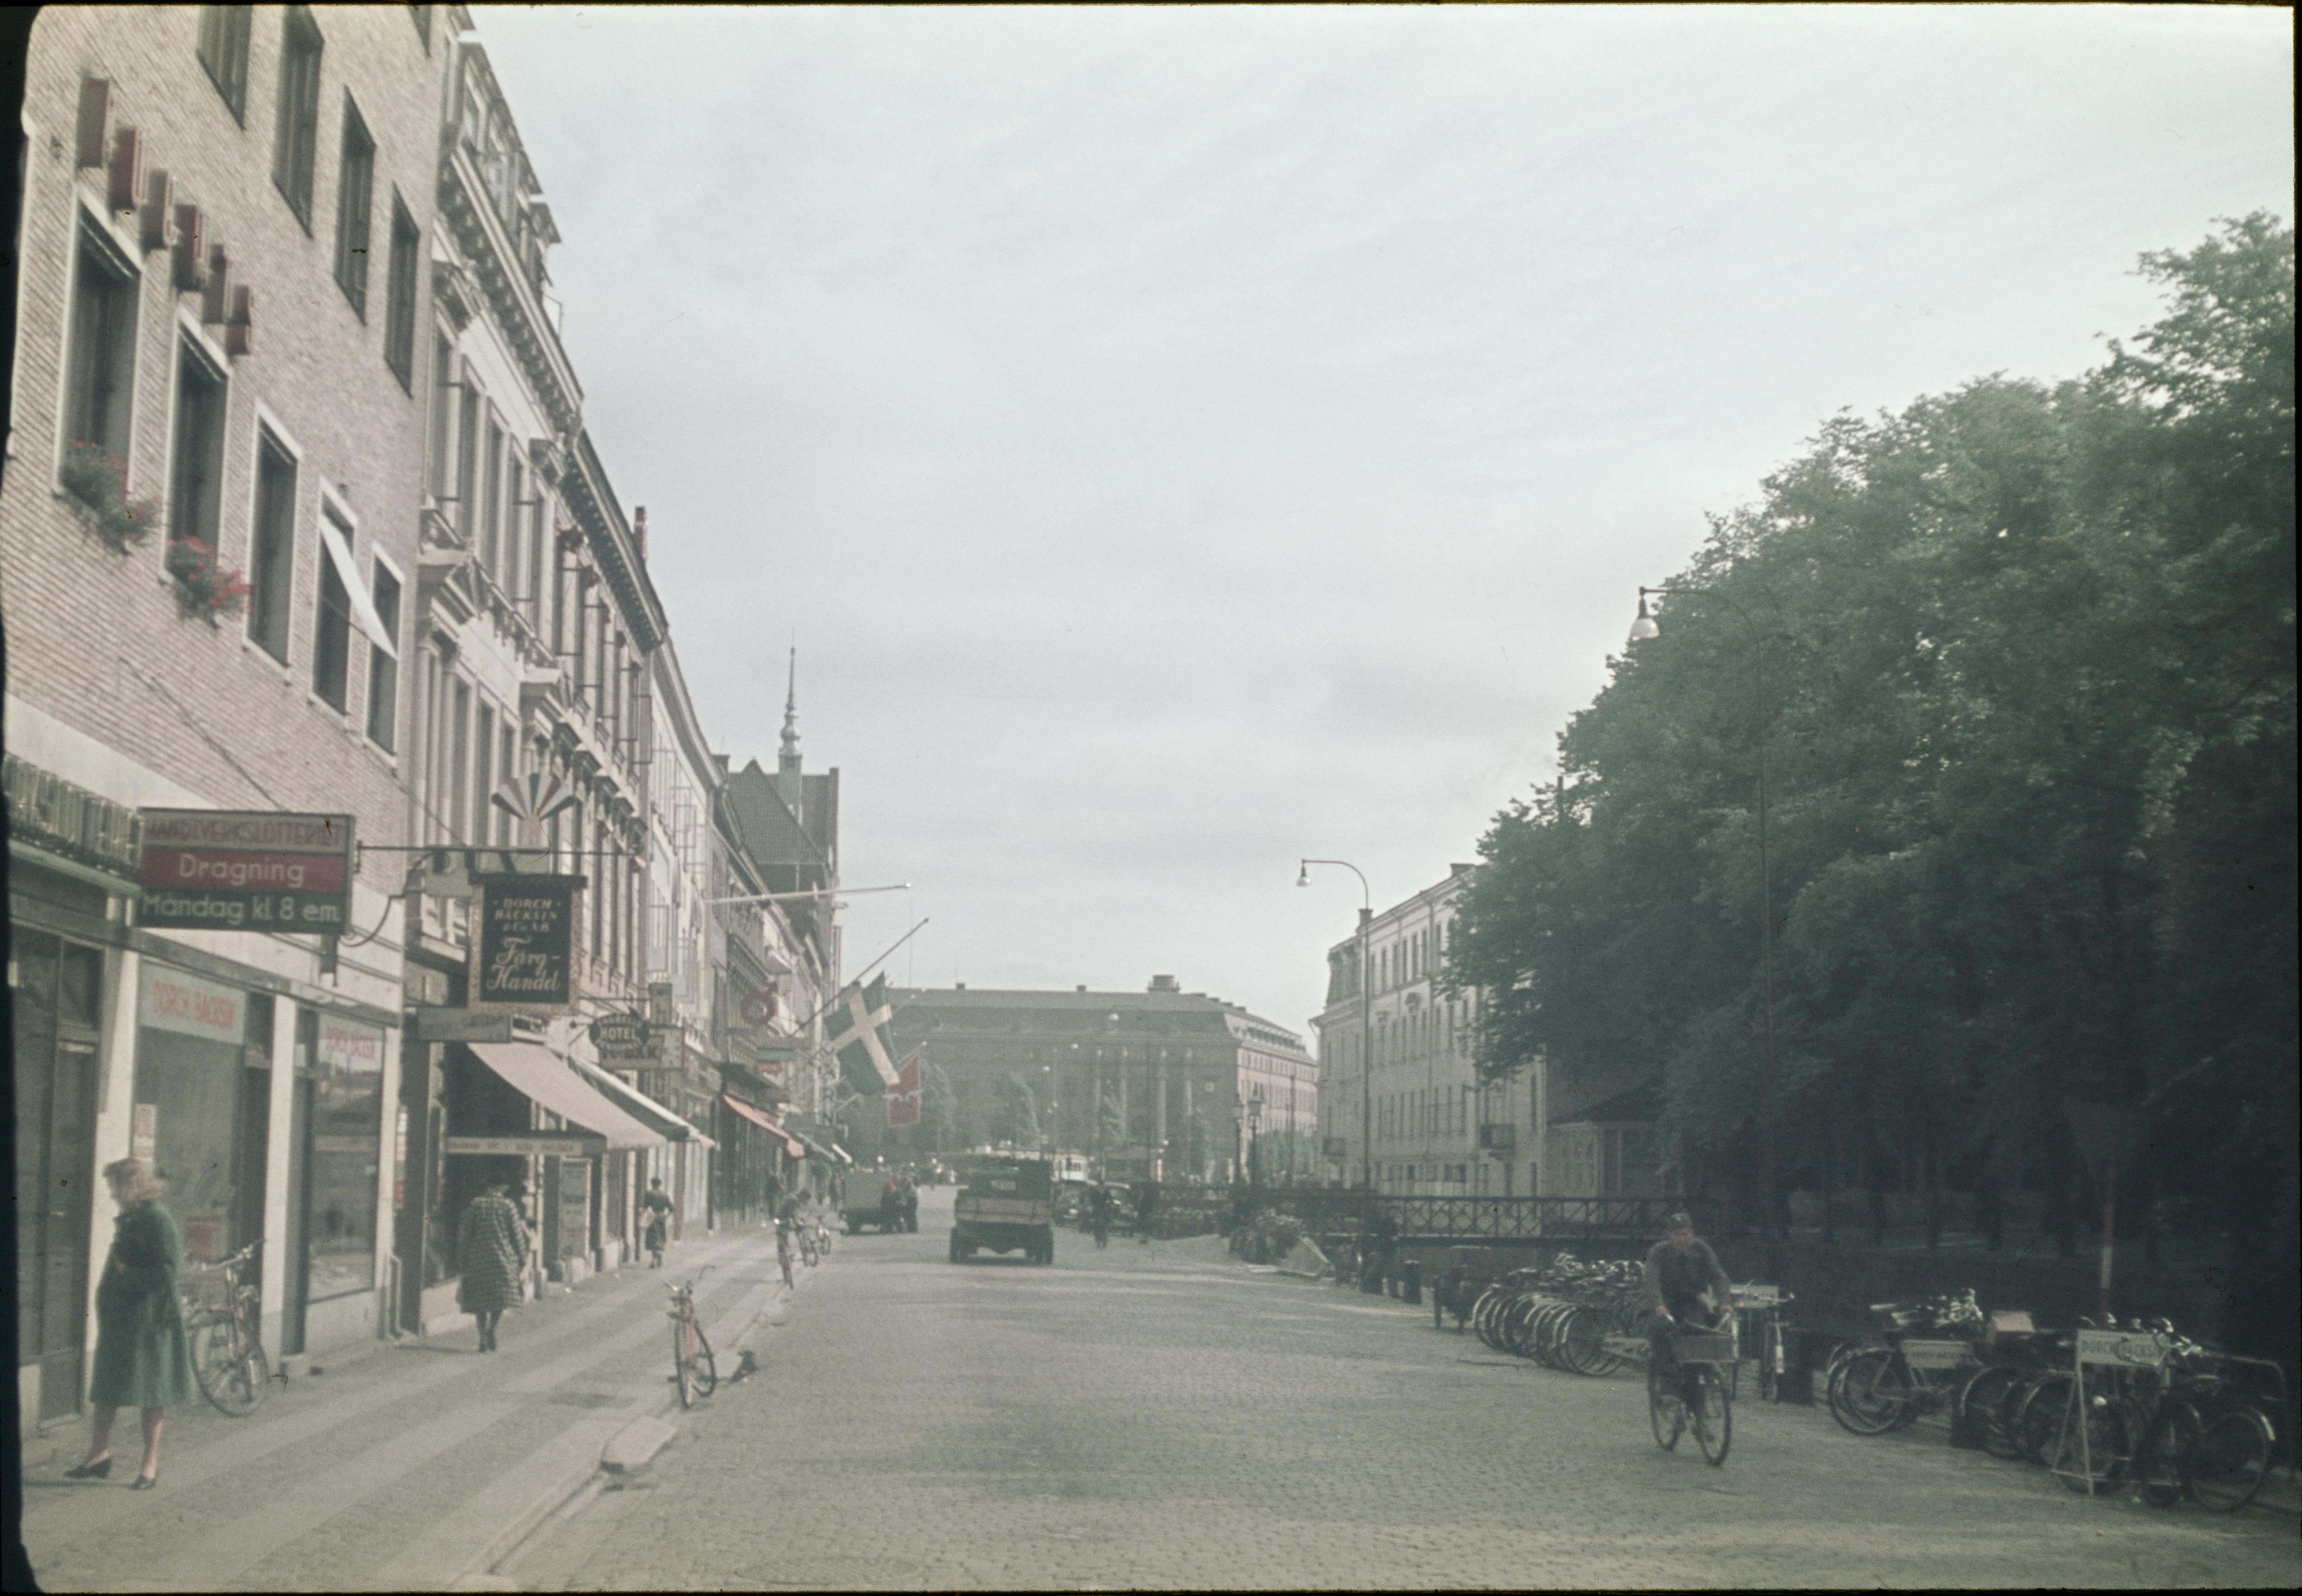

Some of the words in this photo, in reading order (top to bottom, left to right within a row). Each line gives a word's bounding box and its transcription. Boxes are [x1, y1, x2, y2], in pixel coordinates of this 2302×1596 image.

[180, 853, 305, 888] Dragning
[142, 891, 244, 925] Måndag
[279, 896, 294, 920] 8
[486, 964, 560, 991] Handel
[600, 1027, 635, 1040] HOTEL
